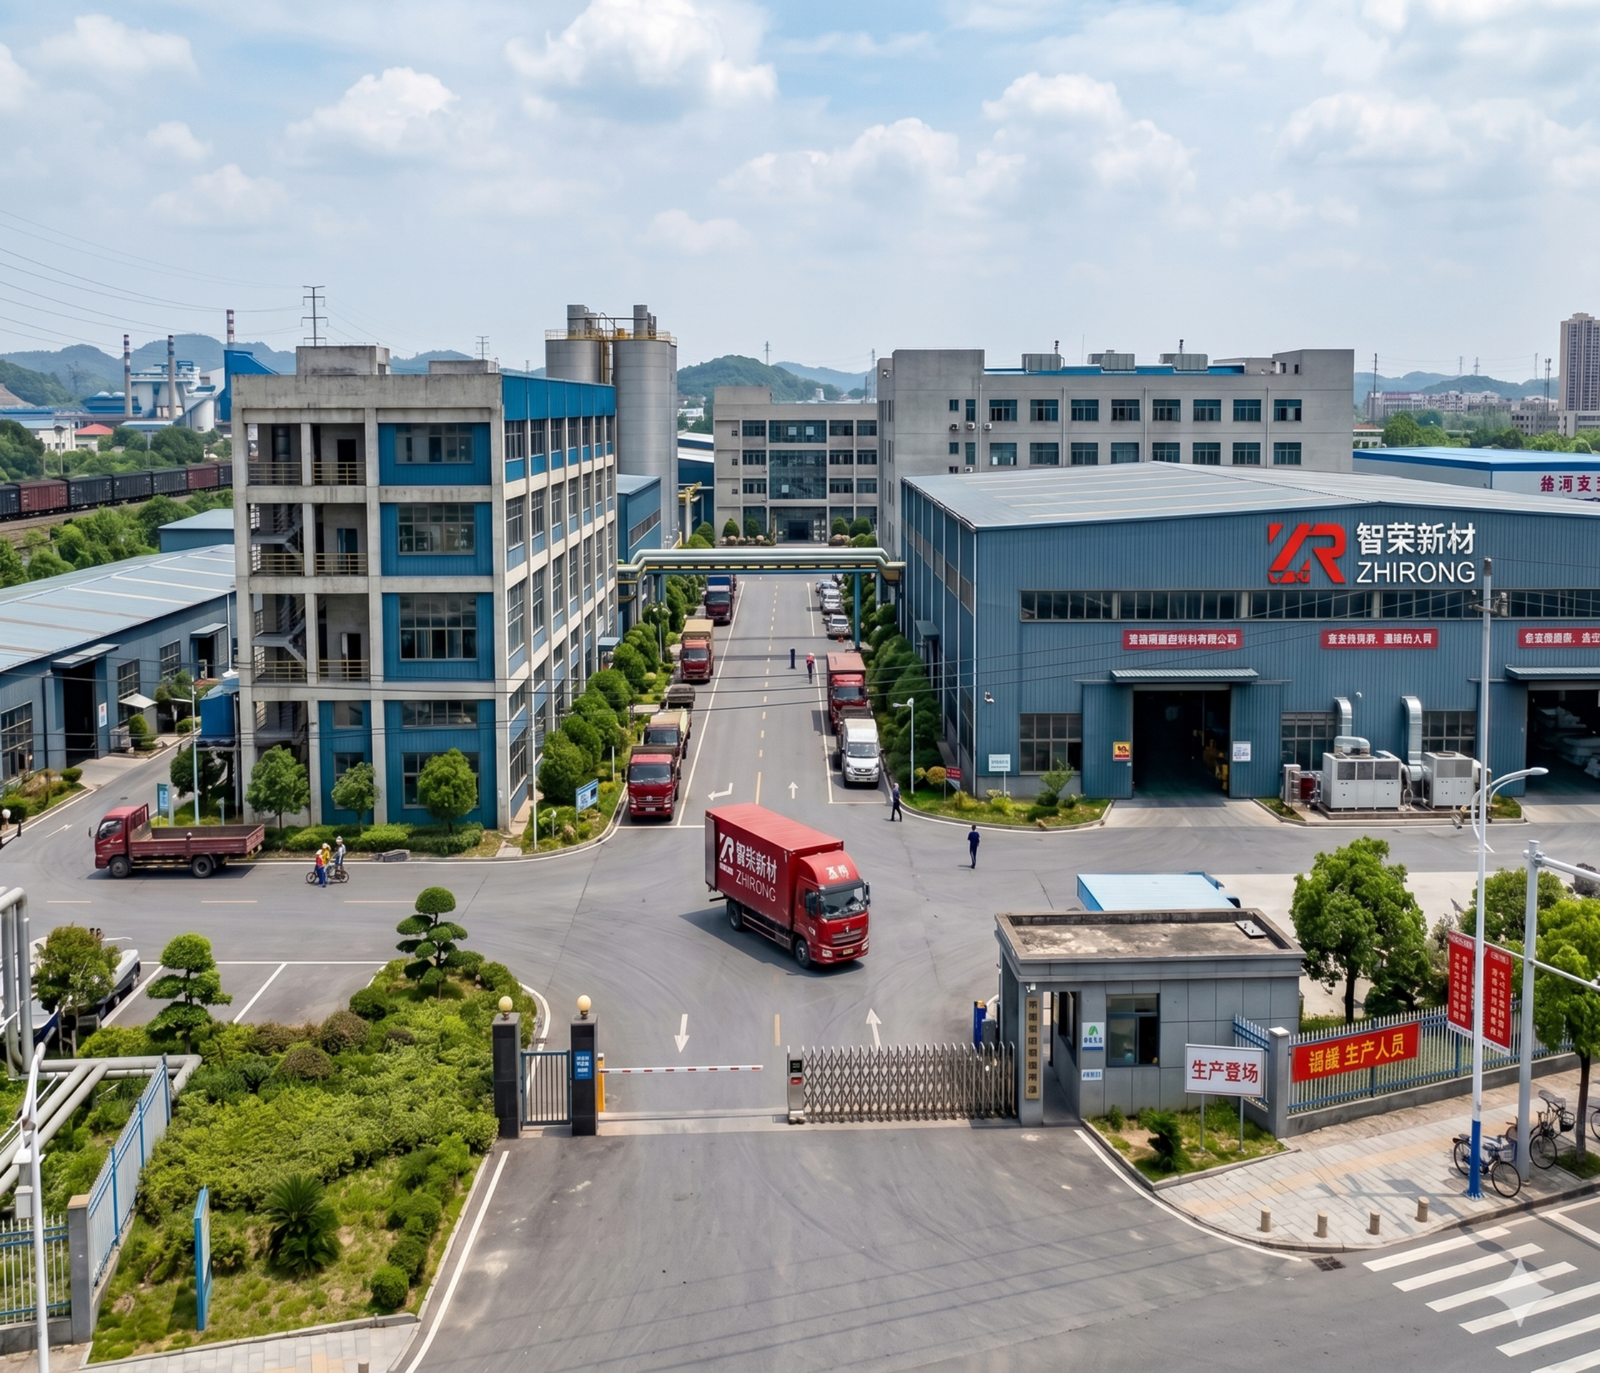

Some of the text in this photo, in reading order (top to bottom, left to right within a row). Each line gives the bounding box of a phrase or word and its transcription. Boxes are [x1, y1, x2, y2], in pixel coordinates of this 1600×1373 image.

[1356, 521, 1476, 555] 智荣新材
[1356, 561, 1476, 584] ZHIRONG
[735, 869, 777, 902] ZHIRONG
[1343, 1032, 1405, 1067] 生产人员
[1191, 1059, 1259, 1084] 生产登场
